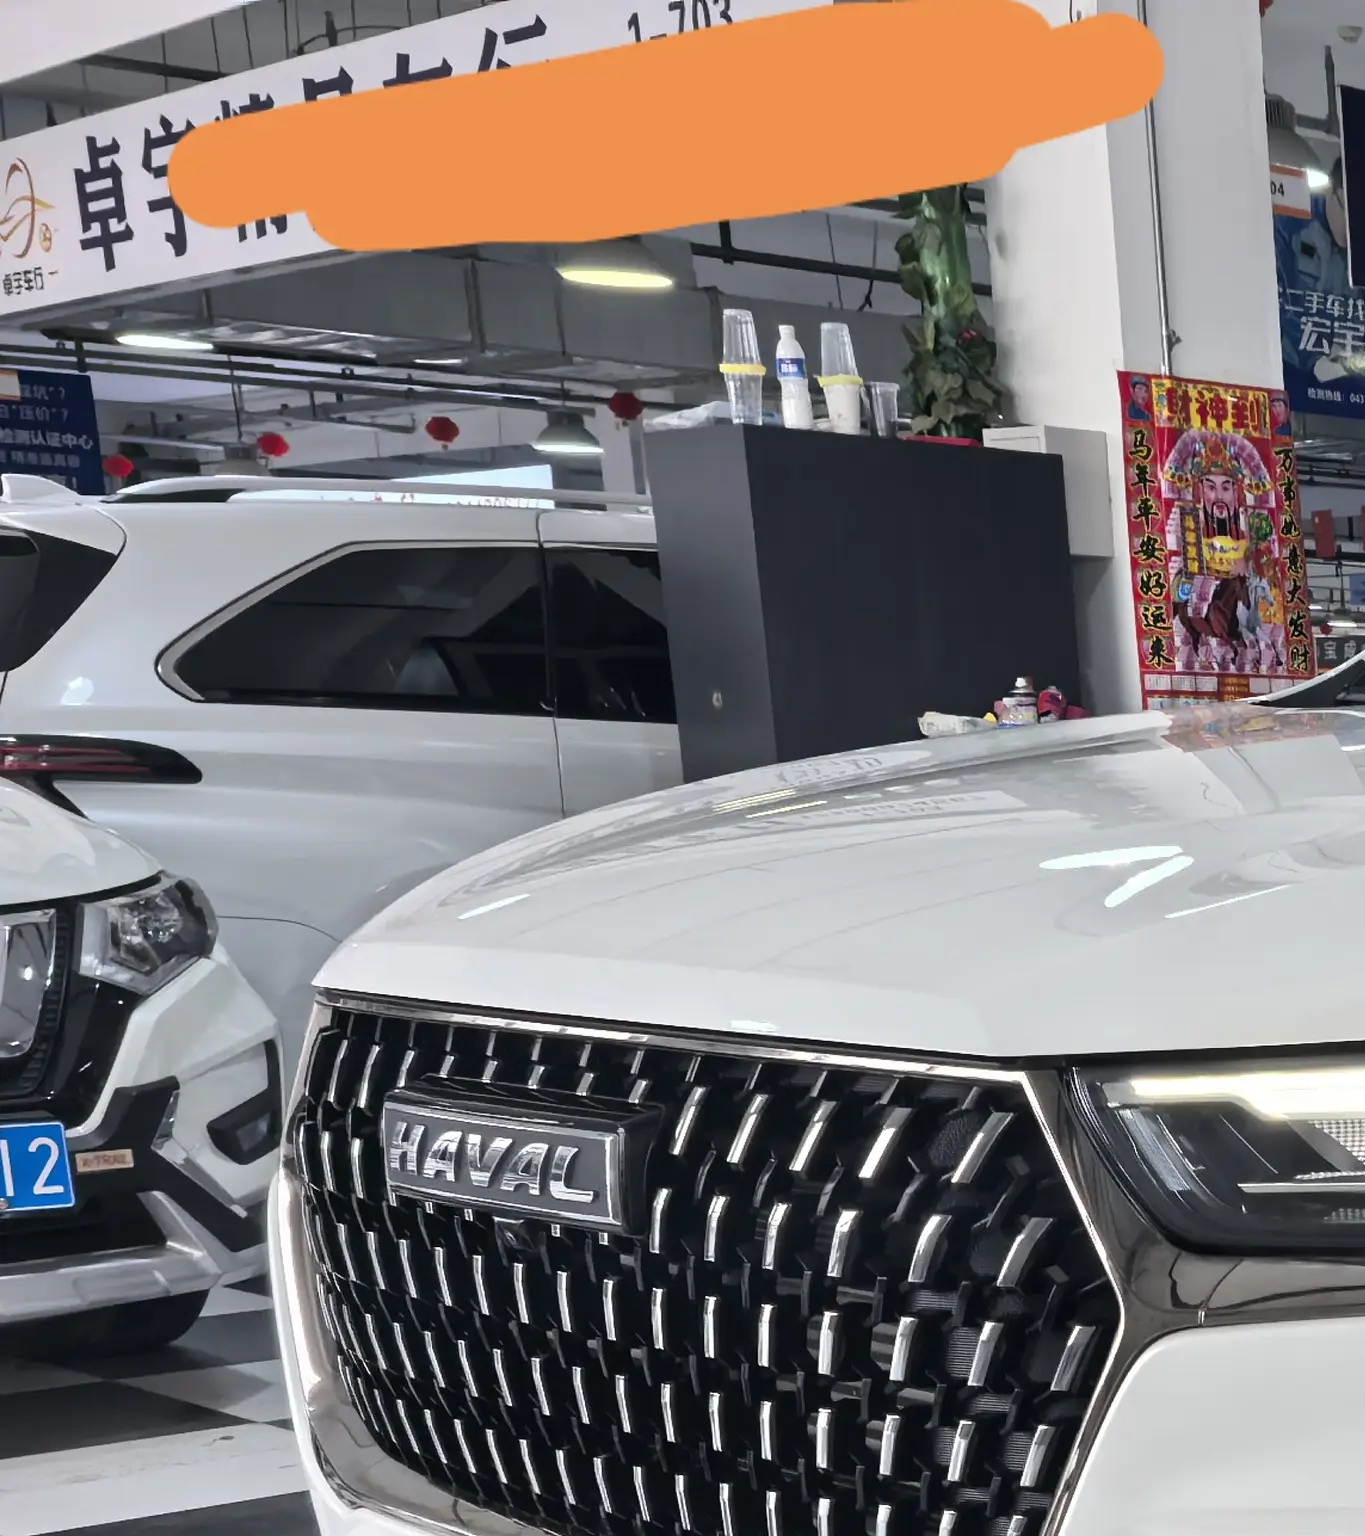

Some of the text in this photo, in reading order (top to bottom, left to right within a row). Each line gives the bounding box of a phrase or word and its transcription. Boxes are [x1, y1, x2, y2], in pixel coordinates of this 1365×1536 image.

[1129, 428, 1175, 668] 马年平安好运来
[1274, 448, 1310, 673] 万事如意大发财
[390, 1121, 595, 1203] HAVAL
